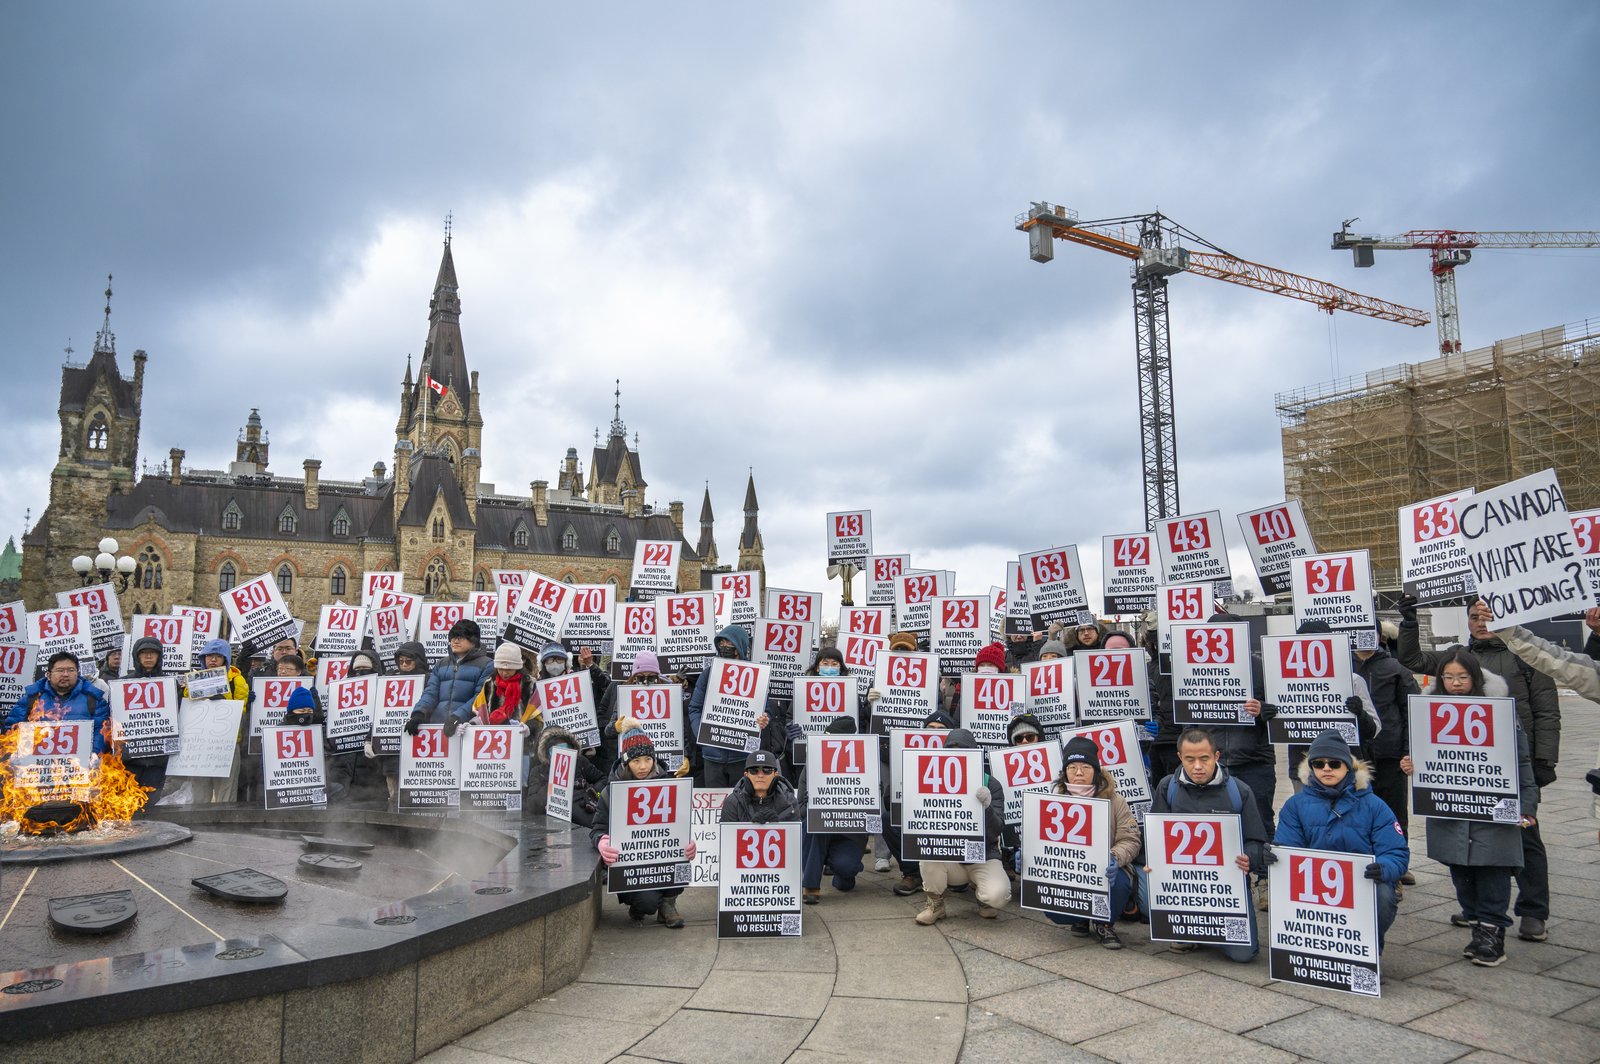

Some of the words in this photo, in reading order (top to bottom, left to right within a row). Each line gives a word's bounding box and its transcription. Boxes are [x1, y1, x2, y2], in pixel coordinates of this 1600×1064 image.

[1418, 506, 1454, 540] 33
[1459, 484, 1567, 540] CANADA
[838, 515, 860, 536] 43
[1173, 519, 1205, 550] 43
[1258, 509, 1289, 542] 40
[645, 544, 668, 565] 22
[1117, 538, 1145, 565] 42
[1177, 551, 1209, 562] MONTHS
[1469, 542, 1528, 583] WHAT
[1532, 532, 1574, 568] ARE
[877, 558, 900, 581] 36
[1036, 553, 1064, 582] 63
[1171, 561, 1202, 571] WAITING
[1204, 559, 1219, 567] FOR
[1185, 567, 1225, 578] RESPONSE
[1311, 558, 1347, 592] 37
[236, 582, 266, 611] 30
[532, 580, 560, 609] 13
[908, 576, 933, 602] 32
[1034, 591, 1062, 601] WAITING
[1040, 582, 1068, 592] MONTHS
[1481, 592, 1517, 621] YOU
[1518, 562, 1587, 609] DOING?
[245, 605, 271, 621] MONTHS
[578, 589, 602, 612] 70
[671, 598, 700, 625] 53
[781, 595, 808, 620] 35
[1047, 596, 1082, 607] RESPONSE
[1171, 588, 1199, 619] 55
[42, 611, 74, 636] 30
[241, 628, 255, 638] IRCC
[255, 613, 287, 632] RESPONSE
[242, 614, 268, 630] WAITING
[268, 608, 281, 618] FOR
[330, 609, 354, 629] 20
[379, 610, 397, 634] 32
[628, 607, 653, 634] 68
[853, 611, 878, 633] 37
[945, 600, 974, 627] 23
[768, 624, 798, 651] 28
[1191, 629, 1228, 662] 33
[849, 638, 876, 665] 40
[1285, 640, 1327, 676] 40
[723, 664, 754, 696] 30
[891, 657, 922, 686] 65
[1033, 667, 1058, 694] 41
[1094, 654, 1126, 685] 27
[127, 682, 160, 708] 20
[340, 680, 364, 708] 55
[386, 680, 410, 706] 34
[548, 678, 578, 707] 34
[635, 690, 666, 718] 30
[720, 697, 749, 708] MONTHS
[809, 682, 840, 711] 90
[977, 678, 1009, 709] 40
[706, 713, 721, 721] IRCC
[721, 715, 757, 727] RESPONSE
[711, 704, 740, 715] WAITING
[741, 709, 754, 718] FOR
[1436, 703, 1487, 744] 26
[36, 726, 74, 753] 35
[281, 730, 309, 757] 51
[416, 730, 444, 756] 31
[476, 730, 507, 756] 23
[826, 740, 859, 772] 71
[1008, 749, 1046, 785] 28
[1437, 749, 1487, 761] MONTHS
[554, 754, 568, 783] 42
[922, 756, 962, 793] 40
[1419, 773, 1444, 783] IRCC
[1446, 775, 1510, 788] RESPONSE
[1425, 761, 1474, 773] WAITING
[1478, 764, 1501, 775] FOR
[632, 786, 671, 823] 34
[923, 798, 961, 808] MONTHS
[1431, 792, 1444, 800] NO
[1446, 793, 1498, 804] TIMELINES
[1436, 802, 1449, 811] NO
[1452, 803, 1494, 815] RESULTS
[908, 820, 927, 829] IRCC
[929, 821, 978, 831] RESPONSE
[913, 809, 951, 818] WAITING
[954, 810, 972, 819] FOR
[1045, 801, 1086, 844] 32
[621, 840, 659, 850] WAITING
[662, 838, 679, 847] FOR
[631, 828, 669, 838] MONTHS
[695, 830, 716, 840] vies
[1170, 822, 1217, 864] 22
[617, 852, 635, 862] RCC
[637, 848, 684, 860] RESPONSE
[740, 830, 780, 867] 36
[1044, 845, 1085, 859] MONTHS
[1028, 867, 1048, 878] IRCC
[1050, 870, 1102, 886] RESPONSE
[1034, 856, 1074, 870] WAITING
[1077, 862, 1096, 873] FOR
[1172, 870, 1218, 881] MONTHS
[730, 885, 769, 894] WAITING
[772, 885, 789, 894] FOR
[740, 874, 779, 882] MONTHS
[1161, 882, 1207, 893] WAITING
[1210, 884, 1232, 894] FOR
[1298, 857, 1344, 905] 19
[724, 897, 744, 906] IRCC
[746, 897, 795, 905] RESPONSE
[1037, 885, 1048, 894] NO
[1049, 887, 1092, 901] TIMELINES
[1041, 895, 1051, 904] NO
[1054, 897, 1088, 910] RESULTS
[1156, 895, 1179, 905] IRCC
[1181, 896, 1239, 907] RESPONSE
[1296, 908, 1346, 925] MONTHS
[1284, 920, 1333, 937] WAITING
[1337, 928, 1360, 941] FOR
[1277, 932, 1302, 946] IRCC
[1305, 937, 1368, 956] RESPONSE
